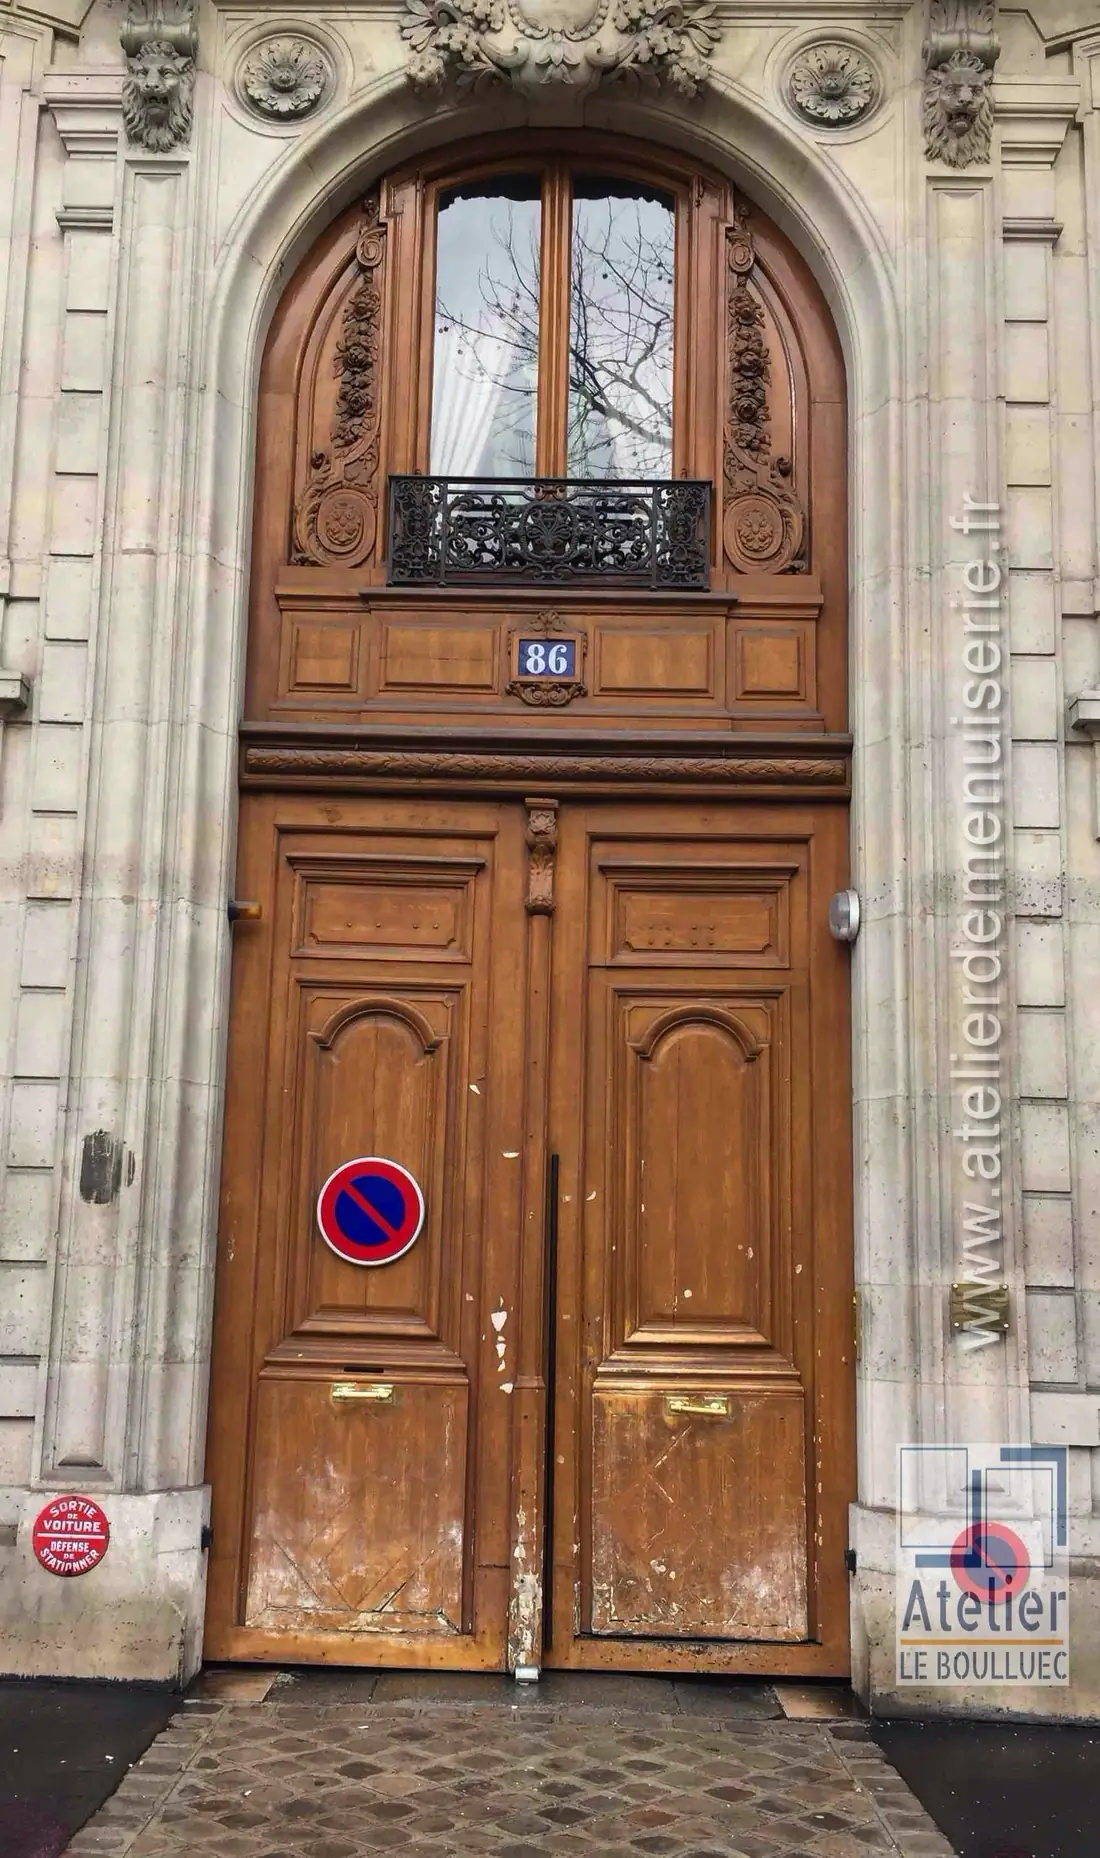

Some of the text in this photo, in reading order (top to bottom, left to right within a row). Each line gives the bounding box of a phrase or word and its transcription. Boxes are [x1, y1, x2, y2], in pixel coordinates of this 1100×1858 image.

[526, 644, 568, 674] 86
[50, 1500, 97, 1519] SORTIE
[43, 1520, 102, 1532] VOITURE
[50, 1541, 90, 1553] DÉFENSE
[40, 1548, 99, 1572] STATIONNER
